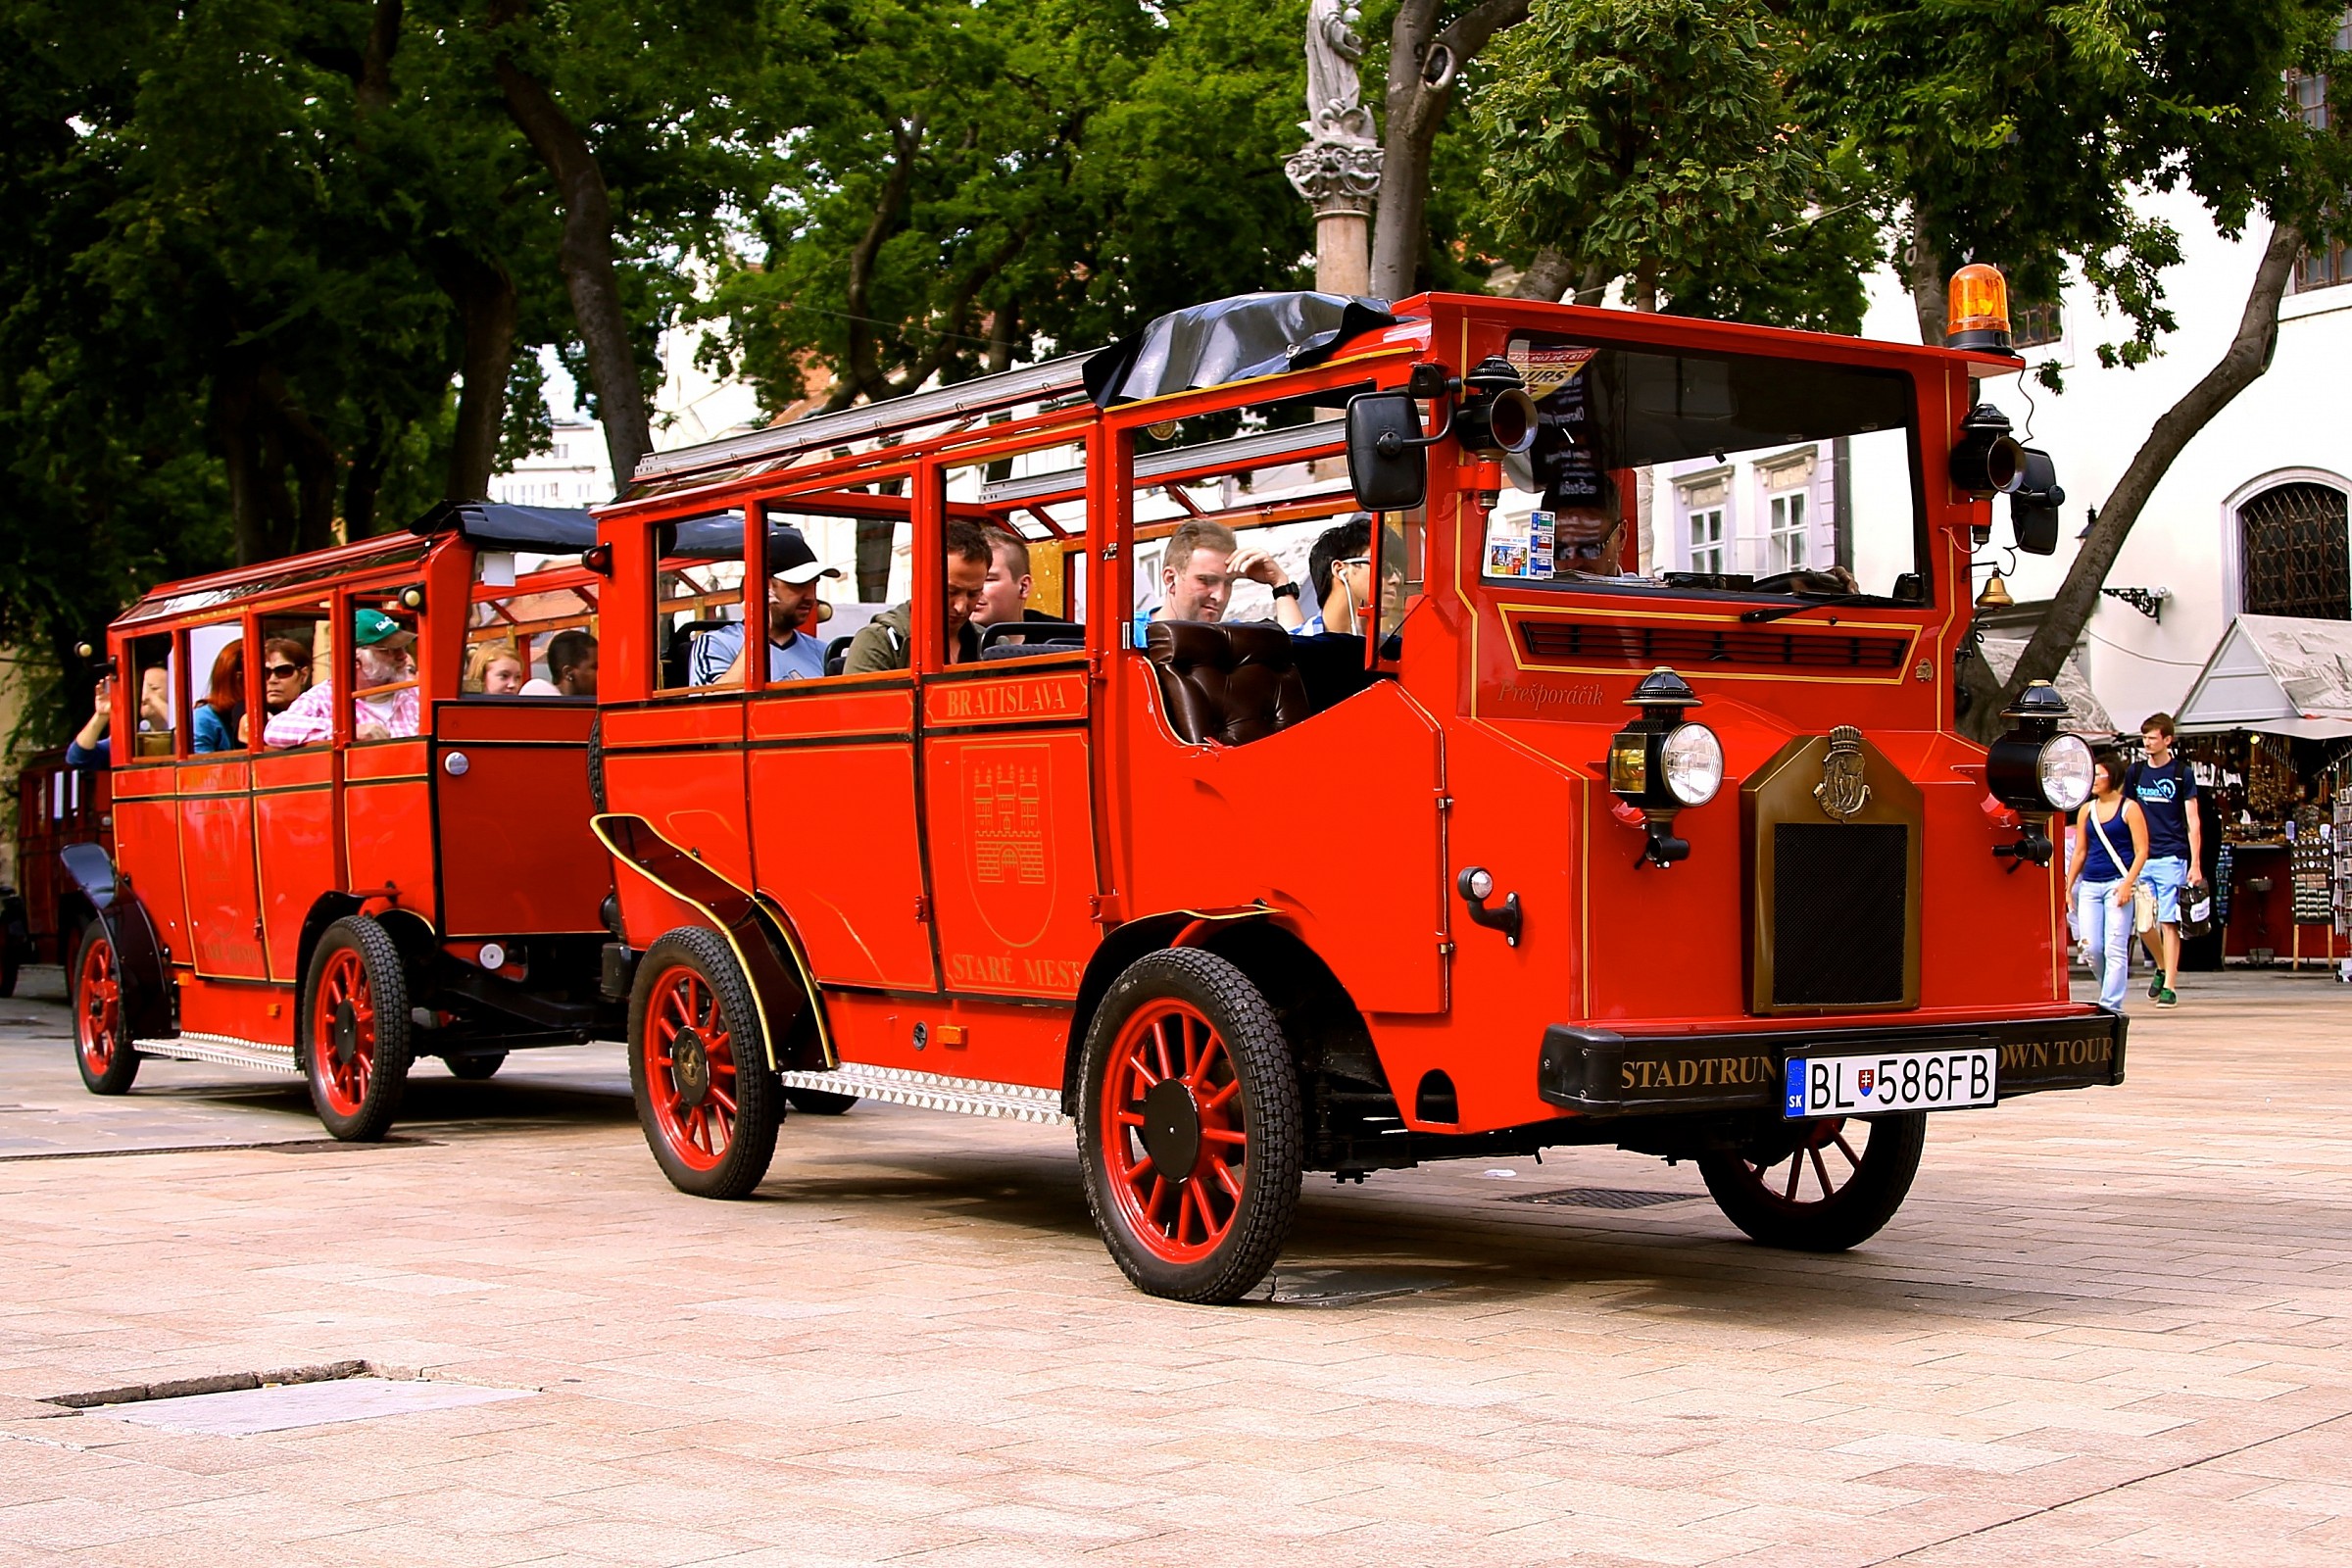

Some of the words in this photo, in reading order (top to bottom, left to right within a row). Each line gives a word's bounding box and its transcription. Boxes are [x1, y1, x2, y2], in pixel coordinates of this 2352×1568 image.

[947, 682, 1066, 717] BRATISLAVA
[1497, 679, 1603, 710] Prešporáčik
[953, 950, 1015, 984] STARÉ
[1024, 958, 1088, 989] MEST
[2054, 1037, 2114, 1066] TOUR
[1788, 1094, 1802, 1108] SK
[1811, 1062, 1855, 1109] BL
[1878, 1054, 1989, 1104] 586FB
